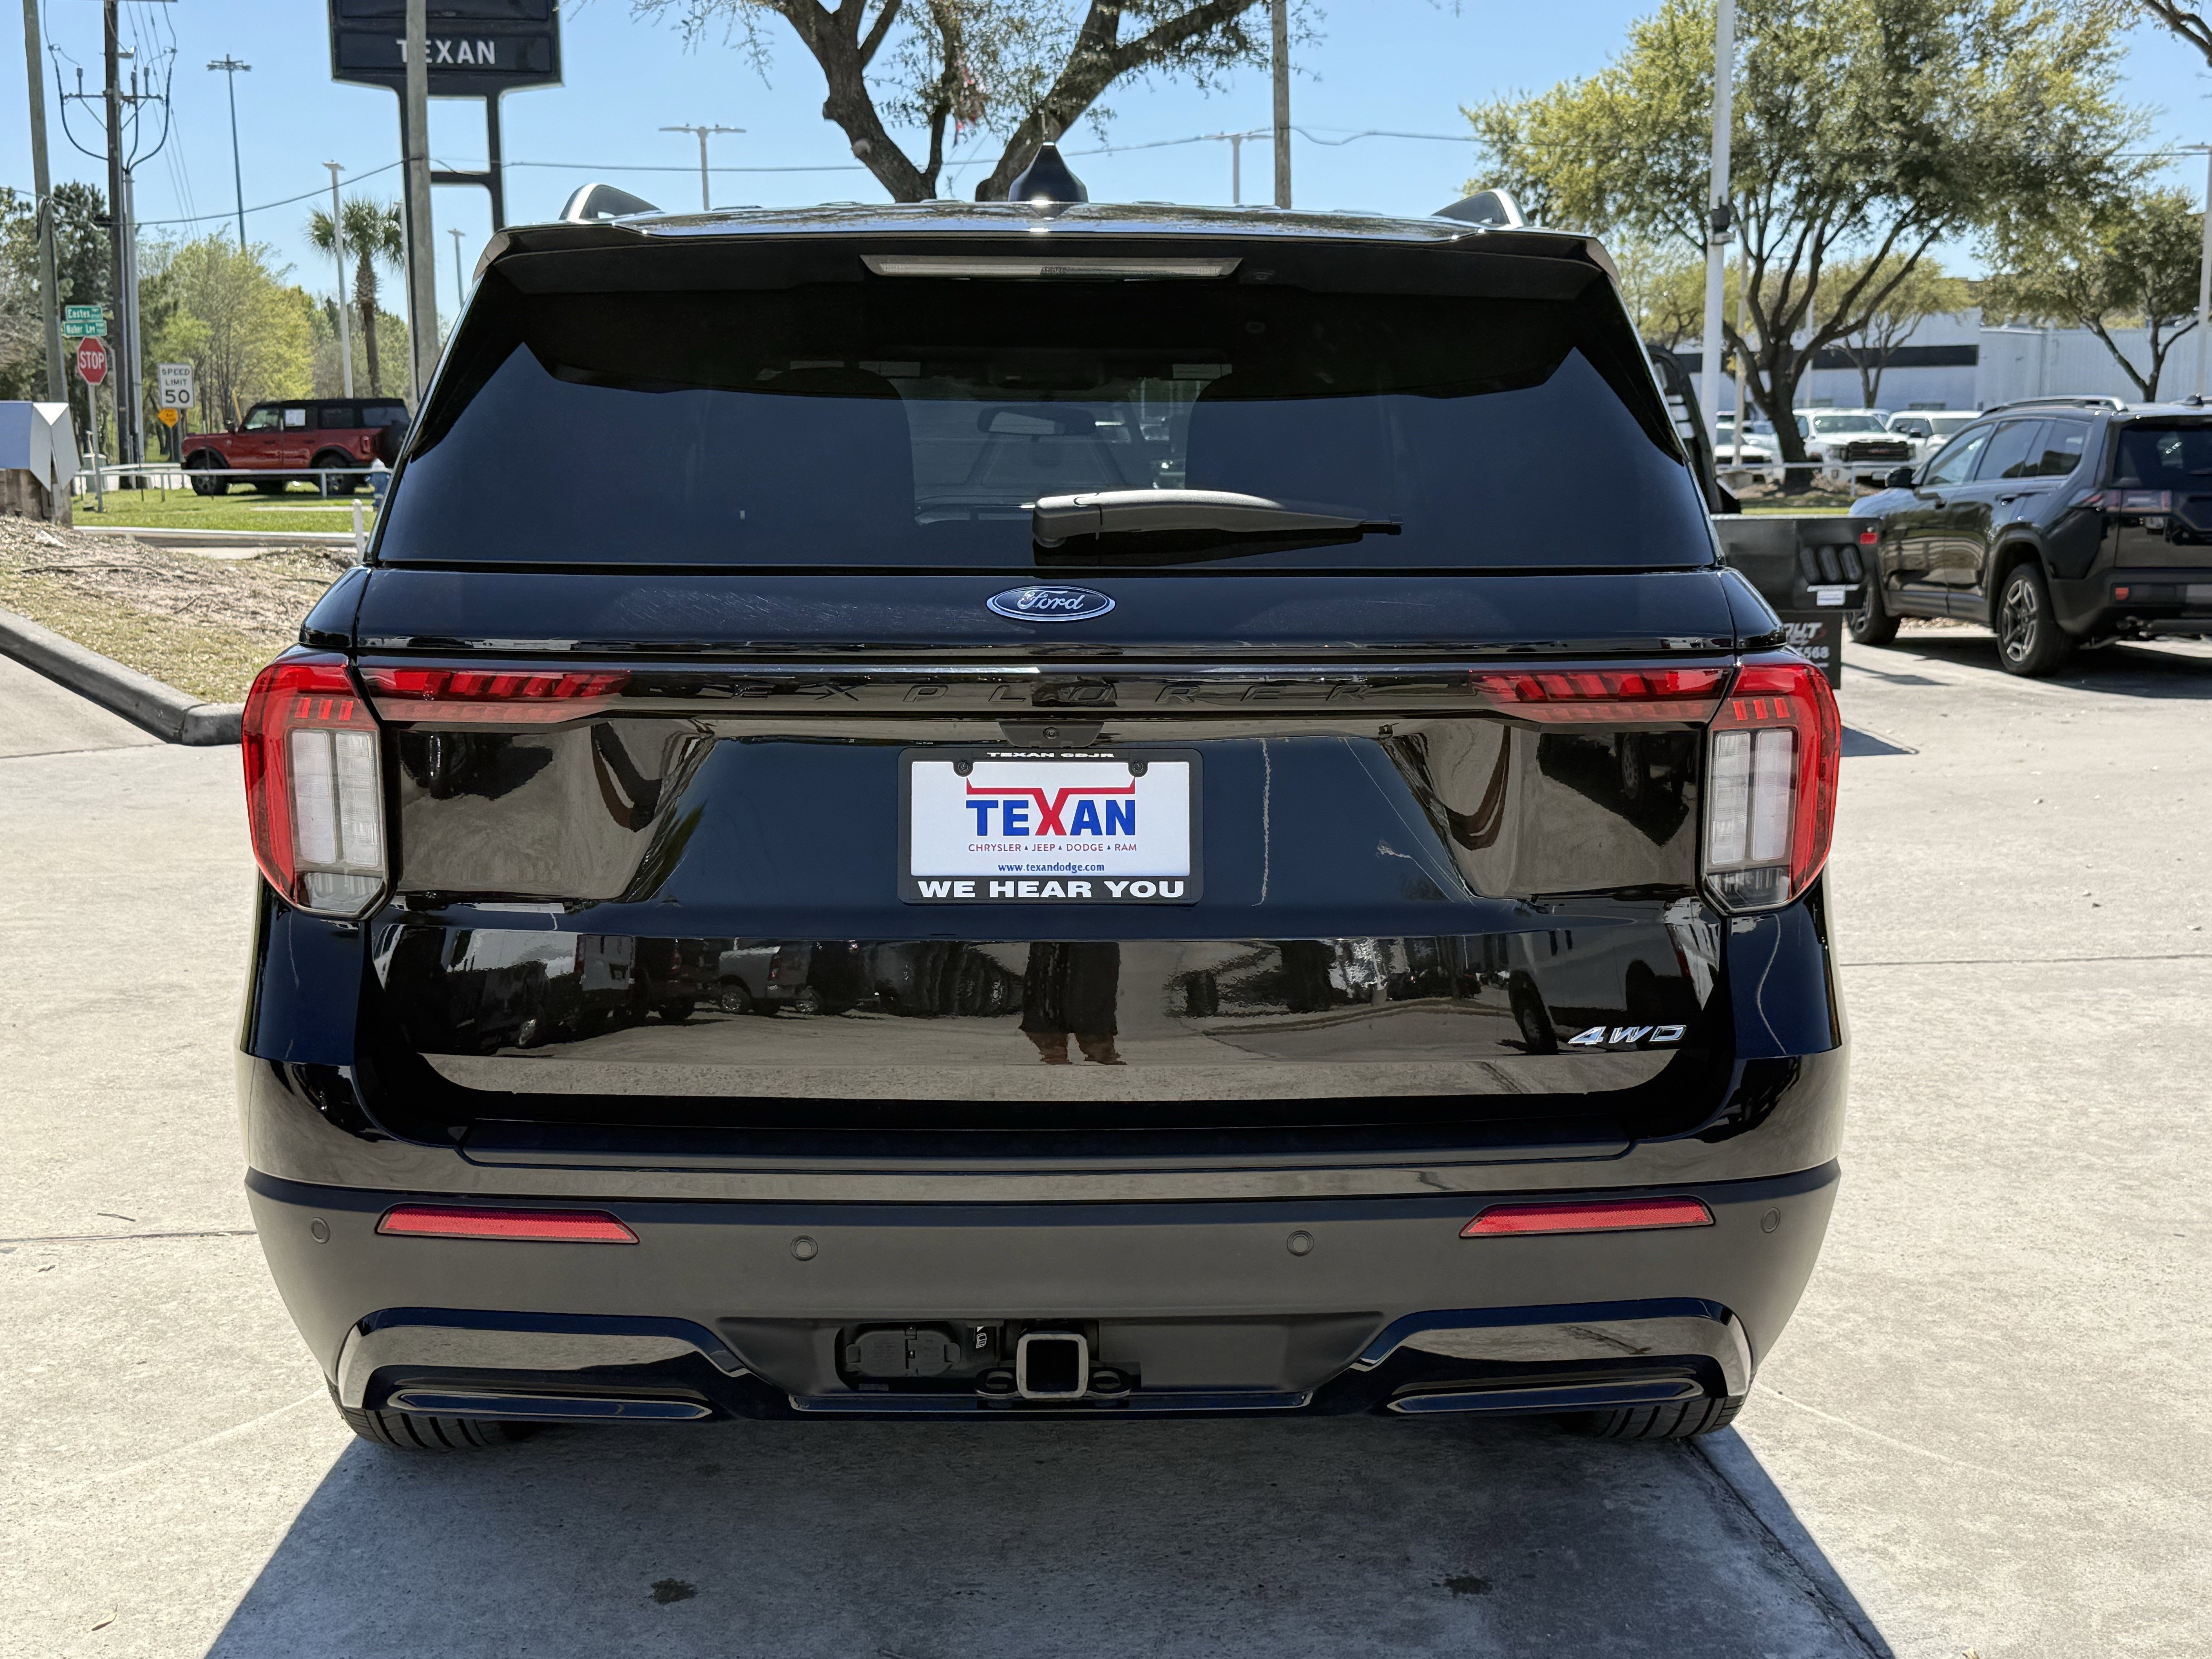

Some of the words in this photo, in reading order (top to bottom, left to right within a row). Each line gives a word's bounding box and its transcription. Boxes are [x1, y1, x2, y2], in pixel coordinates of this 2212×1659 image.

[80, 351, 105, 370] STOP
[165, 390, 190, 404] 50
[1017, 590, 1085, 610] Ford
[730, 683, 1373, 703] EXPLORER
[965, 787, 1136, 836] TEXAN
[968, 843, 1021, 852] CHRYSLER
[1066, 843, 1104, 851] DODGE
[1114, 843, 1137, 851] RAM
[998, 862, 1105, 874] www.texandodge.com
[917, 881, 975, 898] WE
[989, 881, 1092, 898] HEAR
[1104, 881, 1185, 898] YOU
[1568, 1025, 1687, 1045] 4WD
